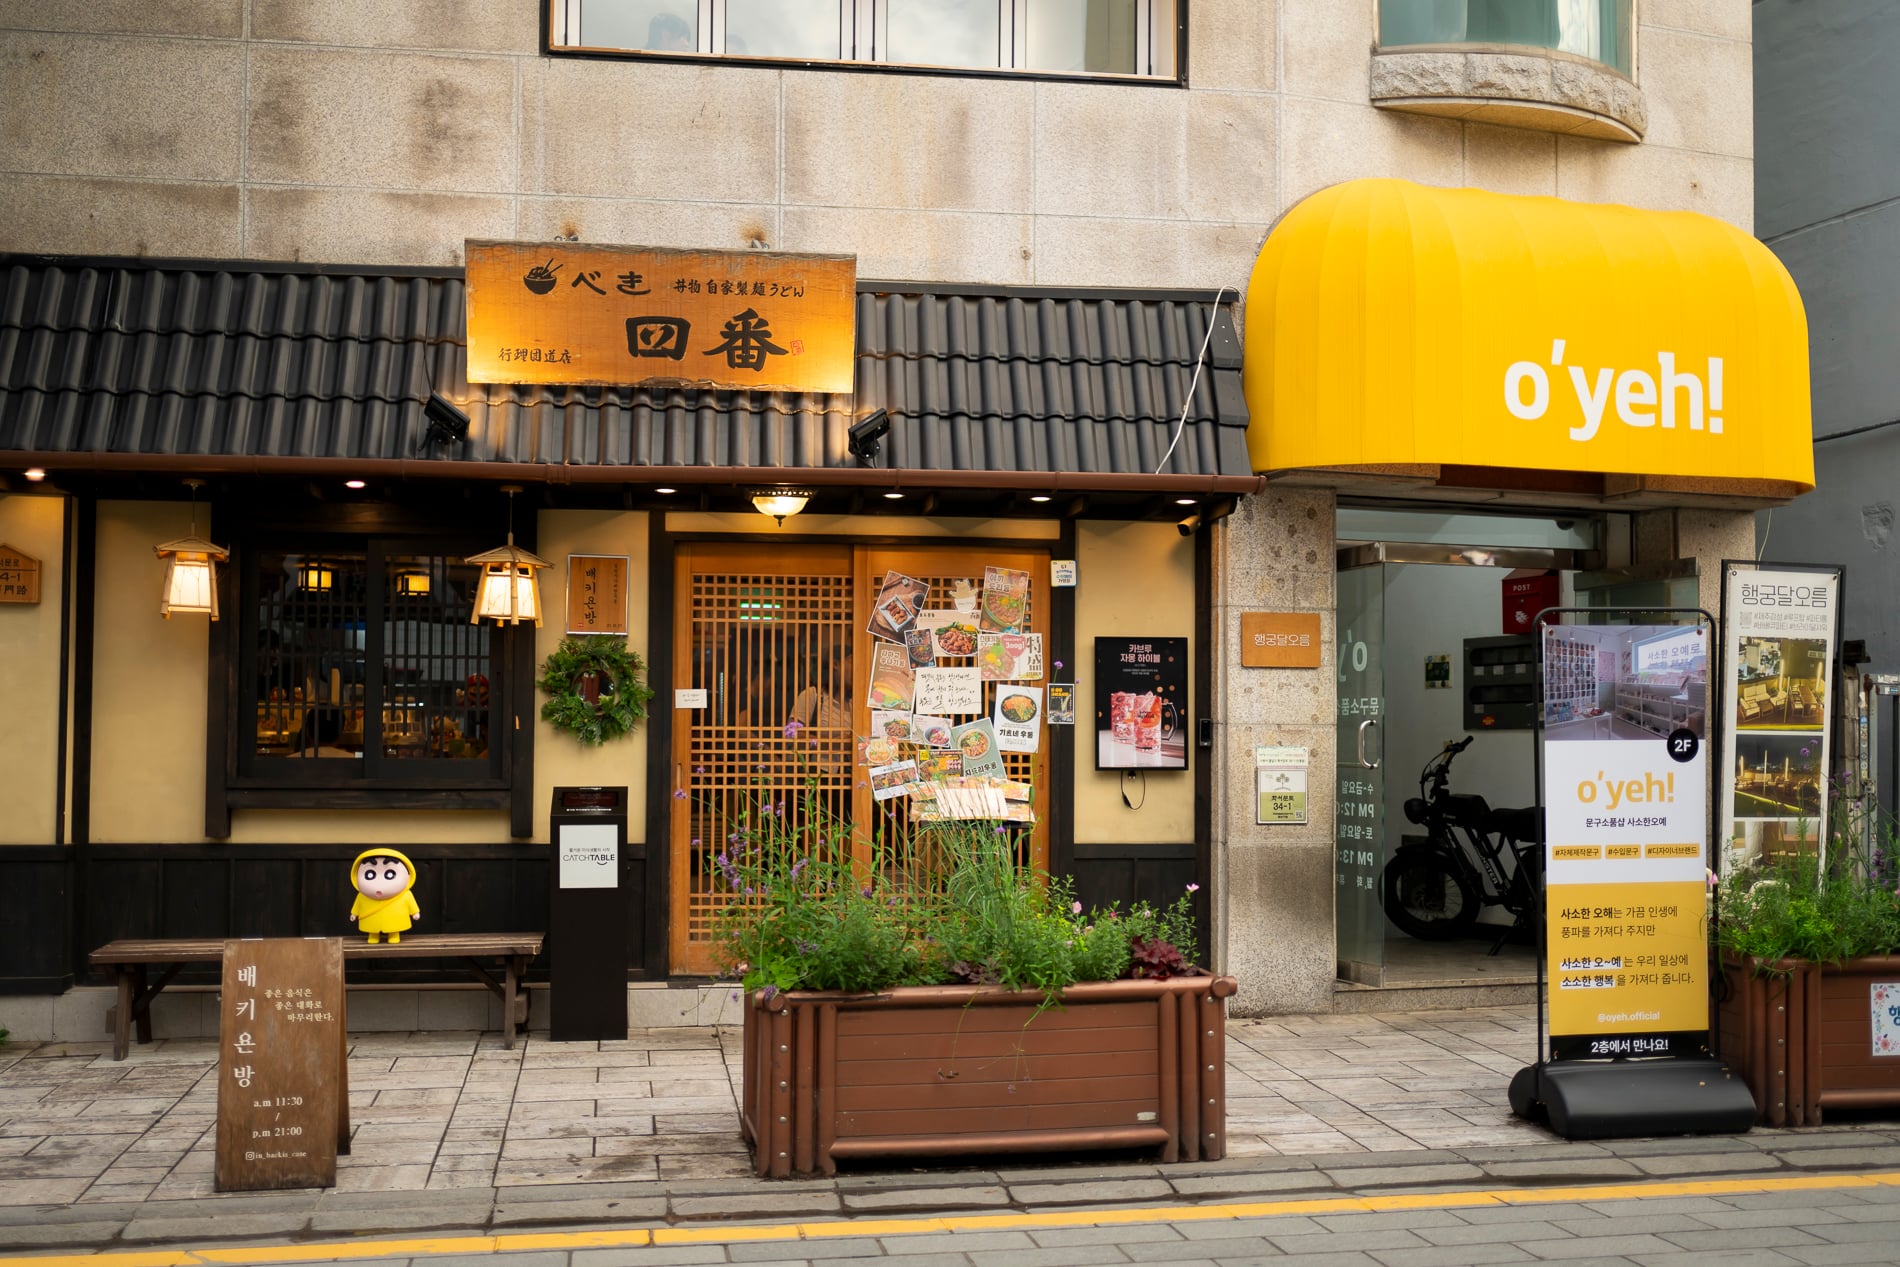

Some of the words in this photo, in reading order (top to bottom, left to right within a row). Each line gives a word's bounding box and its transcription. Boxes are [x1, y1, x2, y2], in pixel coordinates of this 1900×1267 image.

[571, 271, 652, 296] べき
[625, 308, 789, 371] 四番
[1504, 338, 1724, 442] o'yeh!
[1741, 583, 1828, 608] 행궁달오름
[1254, 633, 1310, 647] 행궁달오름
[1120, 653, 1136, 663] 자몽
[1674, 739, 1692, 752] 2F
[1577, 770, 1675, 810] o'yeh!
[1273, 802, 1292, 811] 34-1
[1585, 817, 1625, 828] 문구소품샵
[1607, 846, 1640, 856] #수입문구
[1647, 845, 1698, 855] #디자이너브랜드
[562, 854, 615, 862] CATCHTABLE
[1561, 907, 1591, 920] 사소한
[1593, 906, 1623, 919] 오해는
[1625, 905, 1645, 918] 가끔
[1649, 905, 1678, 918] 인생에
[1561, 926, 1591, 938] 풍파를
[1594, 925, 1624, 938] 가져다
[1626, 925, 1656, 937] 주지만
[1562, 956, 1591, 969] 사소한
[1636, 955, 1656, 967] 우리
[1659, 954, 1688, 967] 일상에
[1562, 976, 1591, 987] 소소한
[1629, 974, 1659, 985] 가져다
[1662, 973, 1694, 985] 줍니다.
[264, 988, 282, 998] 좋은
[286, 987, 313, 998] 음식은
[275, 1001, 293, 1011] 좋은
[296, 1000, 322, 1010] 대화로
[1597, 1011, 1661, 1023] @oyeh.official
[1591, 1039, 1630, 1053] 2층에서
[1633, 1038, 1669, 1052] 만나요!
[276, 1096, 303, 1106] 11:30
[274, 1126, 302, 1137] 21:00
